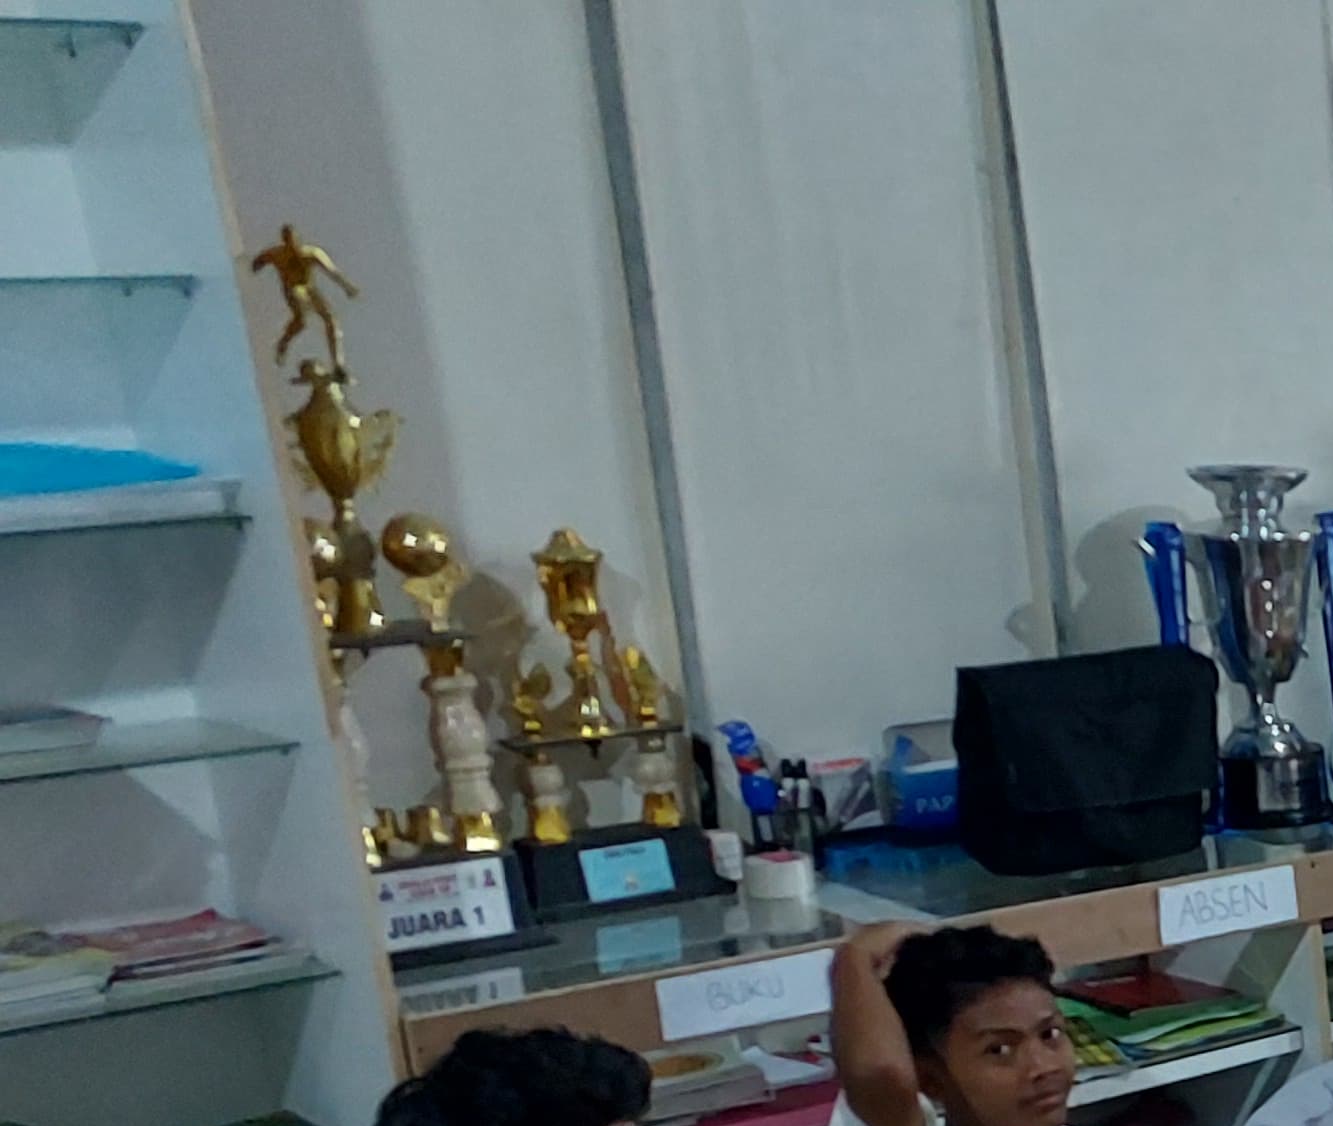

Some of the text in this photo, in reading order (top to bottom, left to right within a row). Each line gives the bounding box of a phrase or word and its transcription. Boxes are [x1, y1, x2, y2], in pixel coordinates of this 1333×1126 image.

[388, 905, 486, 939] JUARA 1
[1180, 881, 1268, 927] ABSEN
[706, 974, 785, 1011] BUKU
